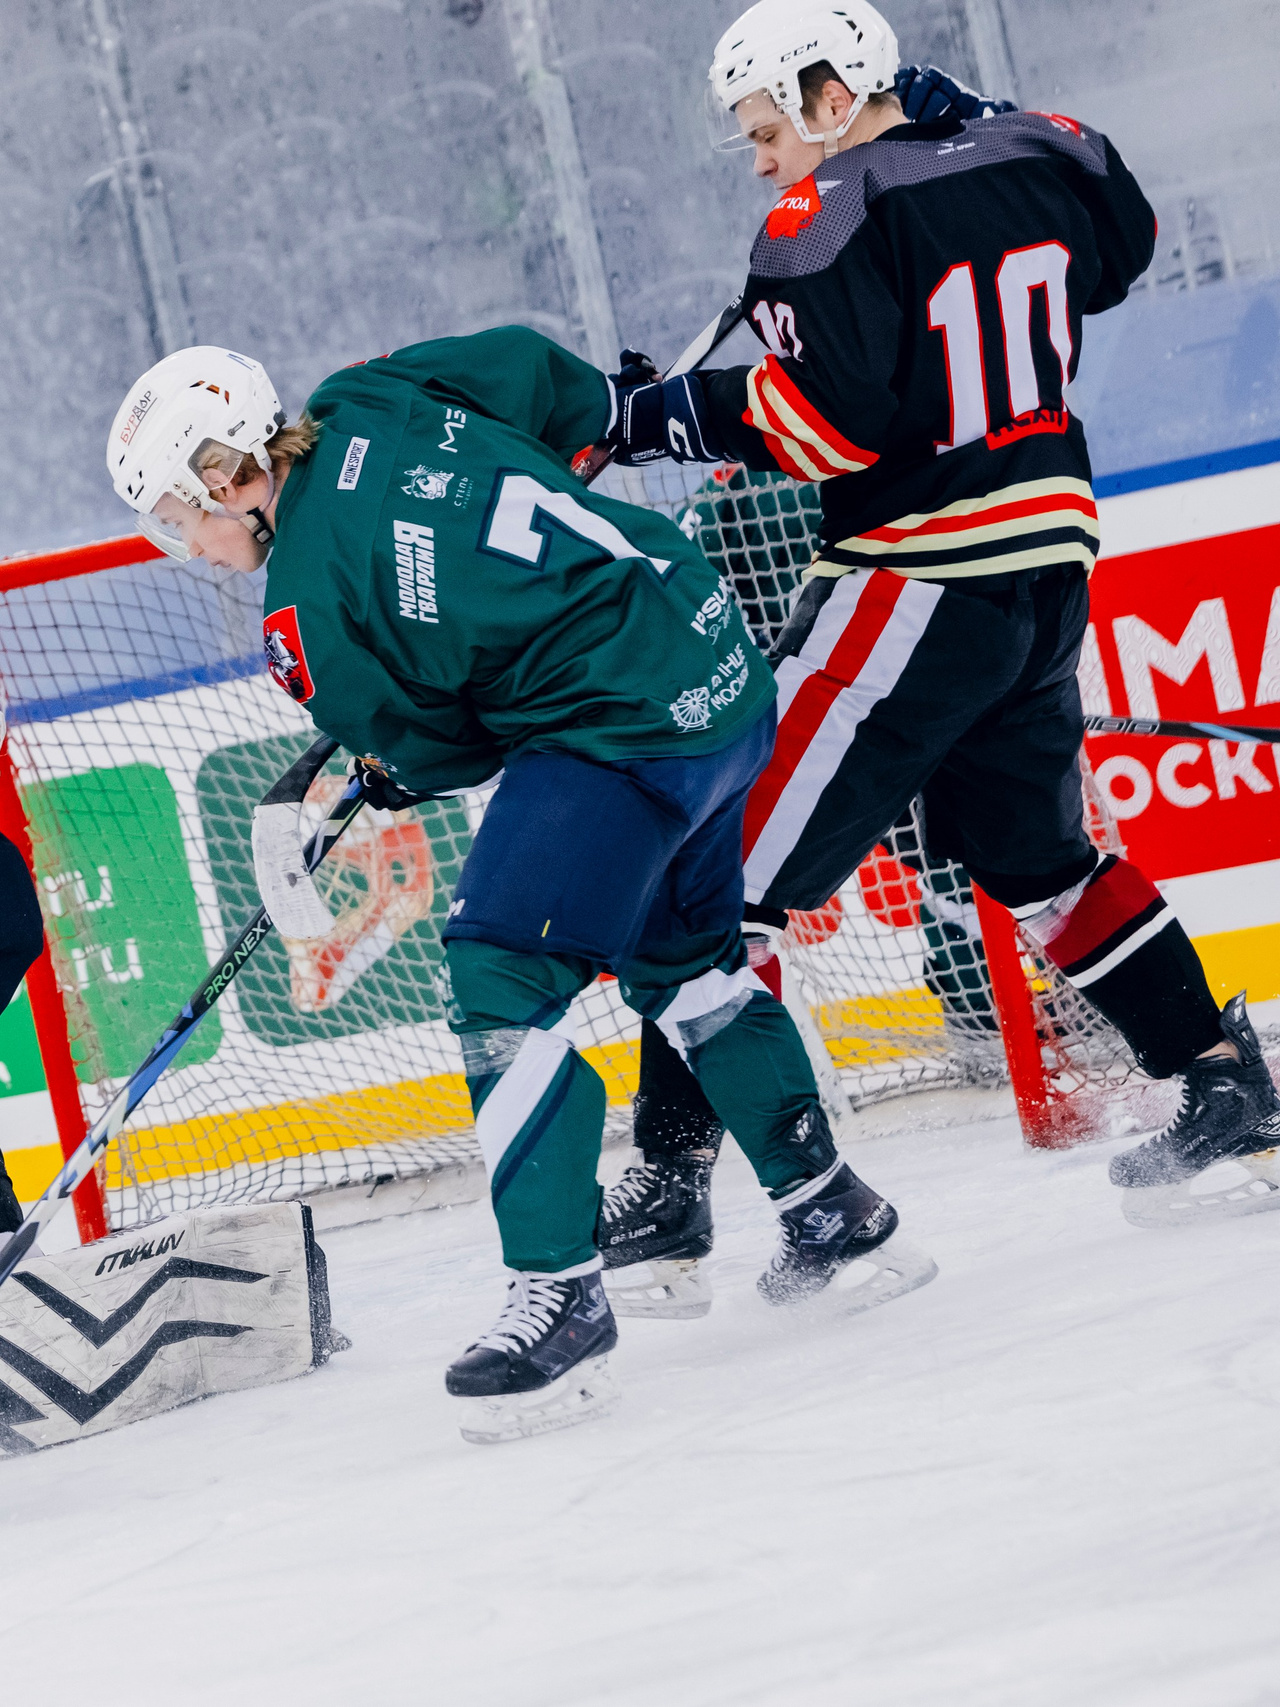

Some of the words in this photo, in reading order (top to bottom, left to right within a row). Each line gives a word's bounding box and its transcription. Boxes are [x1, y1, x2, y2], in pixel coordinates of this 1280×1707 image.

[780, 39, 818, 63] CCM
[751, 300, 803, 363] 10
[927, 239, 1073, 456] 10
[453, 476, 469, 507] СТЕПЬ
[477, 468, 680, 586] 7
[393, 519, 434, 620] МОЛОДАЯ
[410, 521, 440, 624] ГВАРДИЯ
[203, 962, 235, 1005] PRO
[233, 911, 272, 965] NEXT
